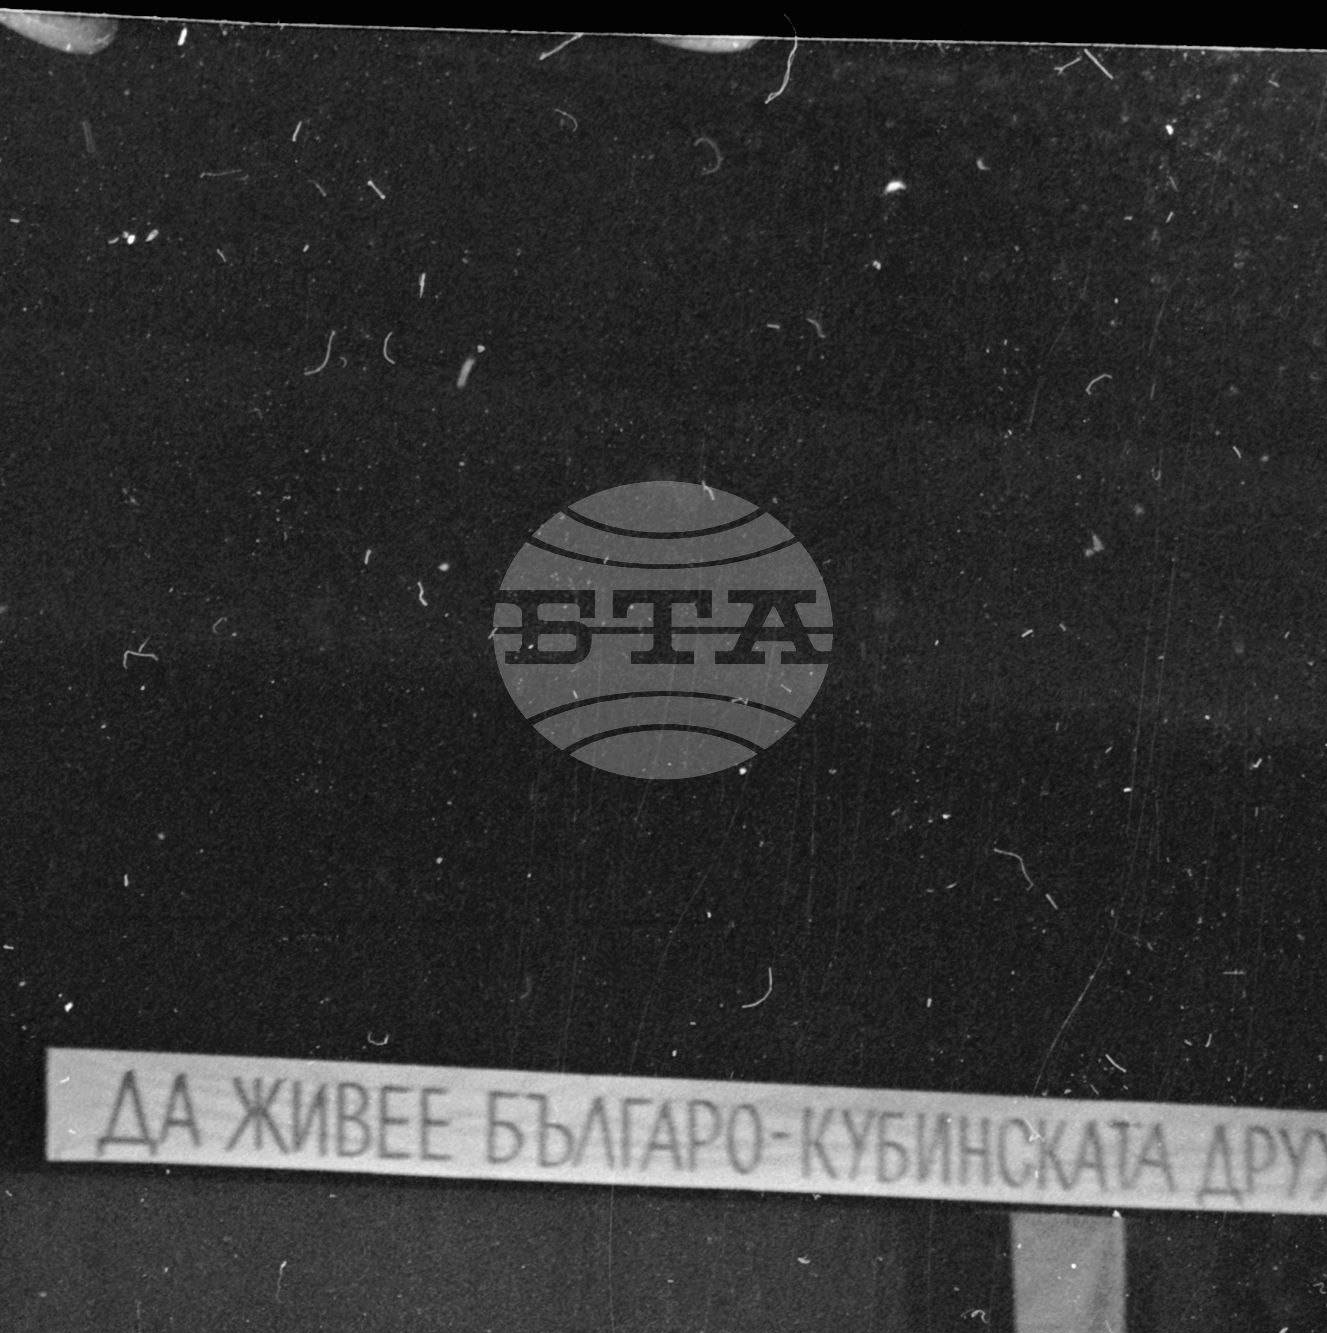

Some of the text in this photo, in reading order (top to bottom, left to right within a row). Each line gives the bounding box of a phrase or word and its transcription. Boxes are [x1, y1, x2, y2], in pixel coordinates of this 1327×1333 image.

[96, 1069, 201, 1156] ДА
[225, 1076, 454, 1161] ЖИВЕЕ
[485, 1089, 1178, 1193] БЪЛГАРО-КУБИНСКАТА
